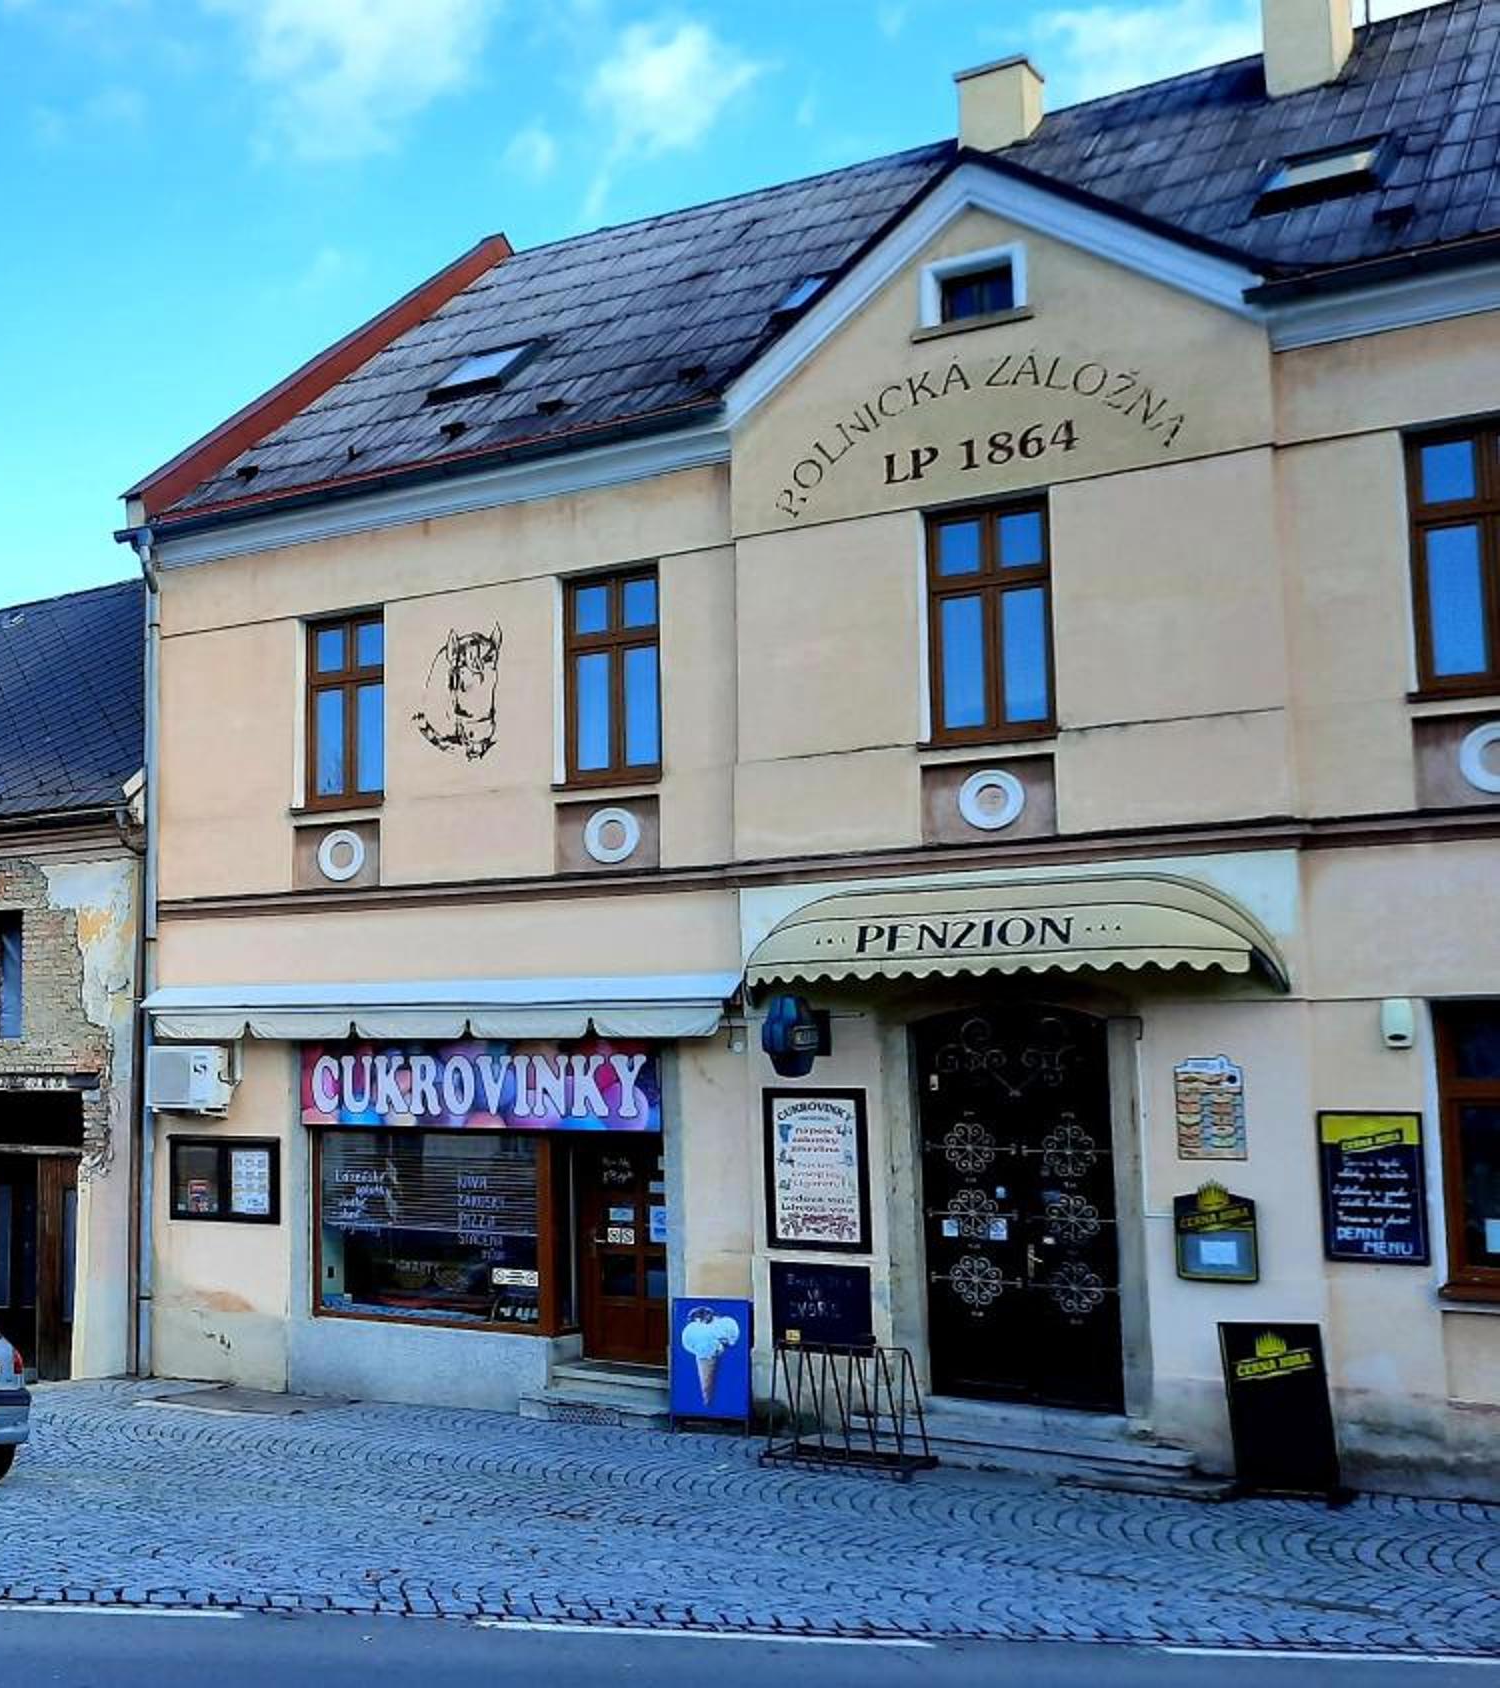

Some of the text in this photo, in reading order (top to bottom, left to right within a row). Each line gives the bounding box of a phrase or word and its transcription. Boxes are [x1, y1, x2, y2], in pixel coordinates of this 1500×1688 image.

[775, 349, 1186, 518] ROLNICKÁ ZÁLOŽNA
[883, 418, 1080, 485] LP 1864
[855, 917, 1074, 953] PENZION
[312, 1054, 648, 1118] CUKROVINKY
[777, 1101, 853, 1121] CUKROVINKY
